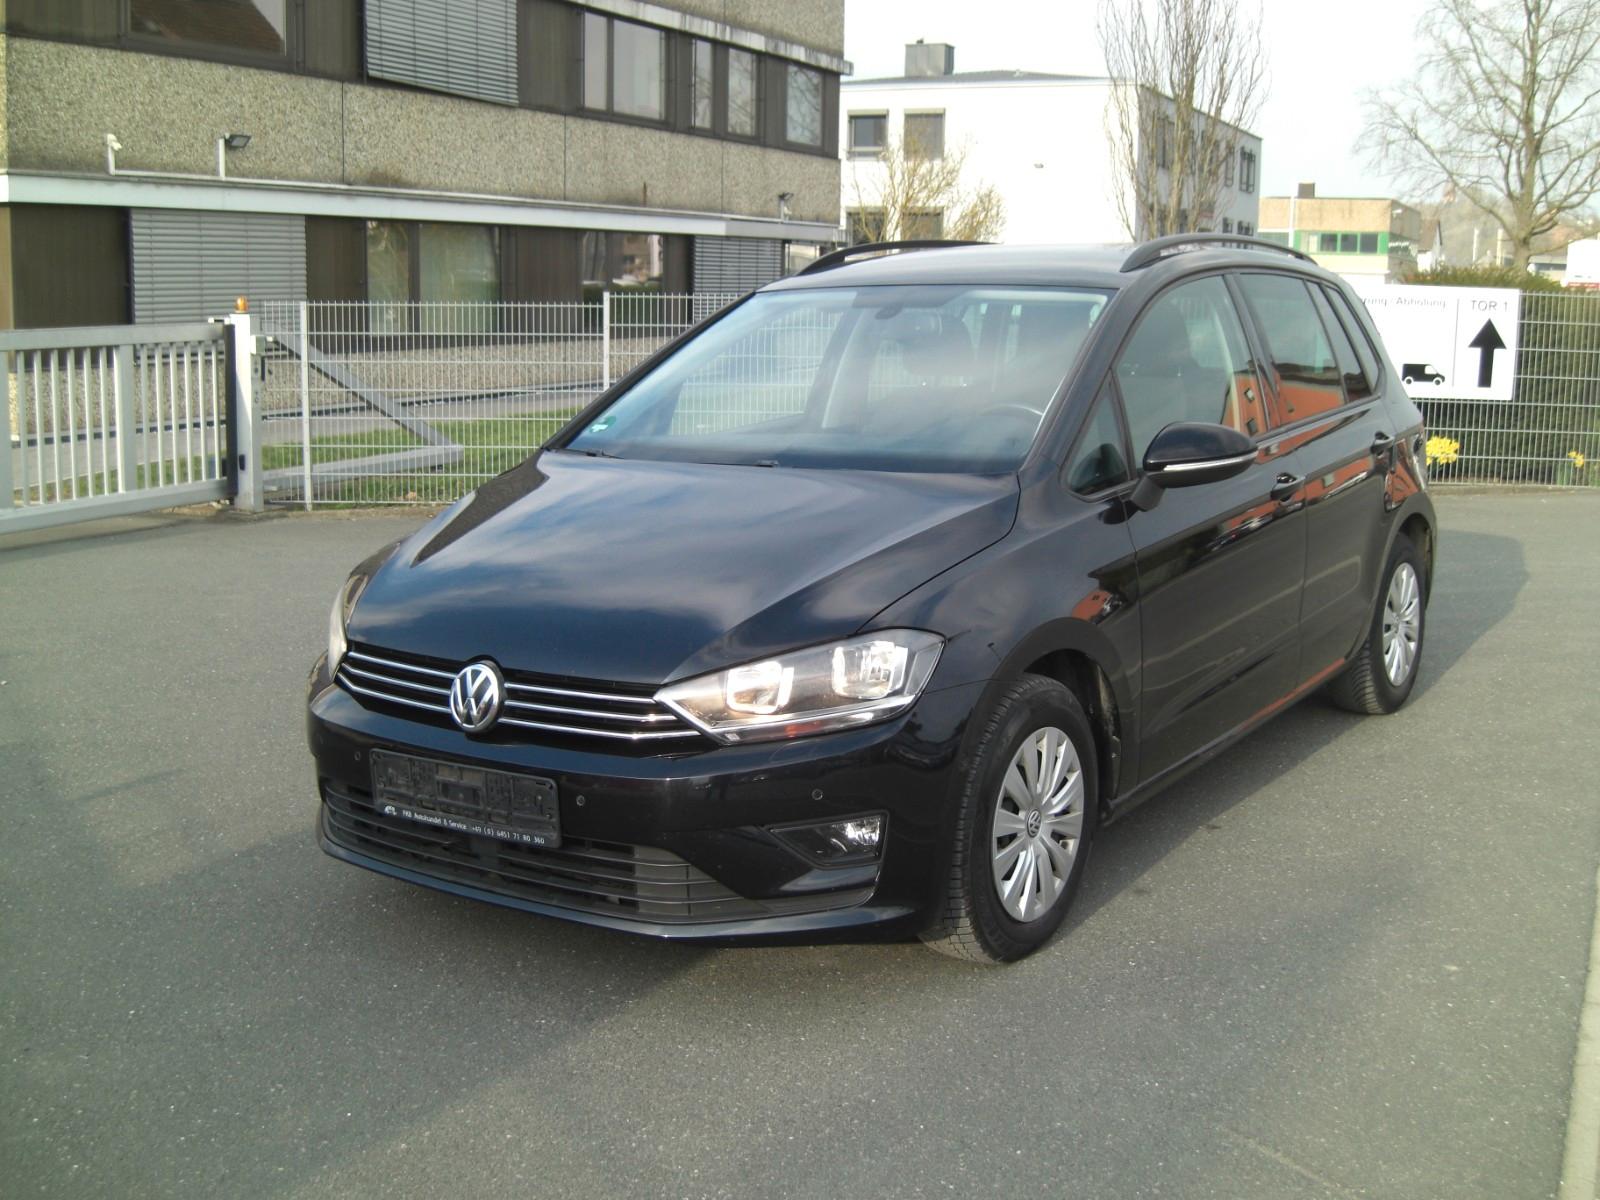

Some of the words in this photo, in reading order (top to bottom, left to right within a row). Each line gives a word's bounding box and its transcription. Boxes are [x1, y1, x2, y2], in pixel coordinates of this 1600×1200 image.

[1470, 299, 1498, 311] TOR
[1503, 301, 1508, 312] 1
[448, 819, 467, 830] Service
